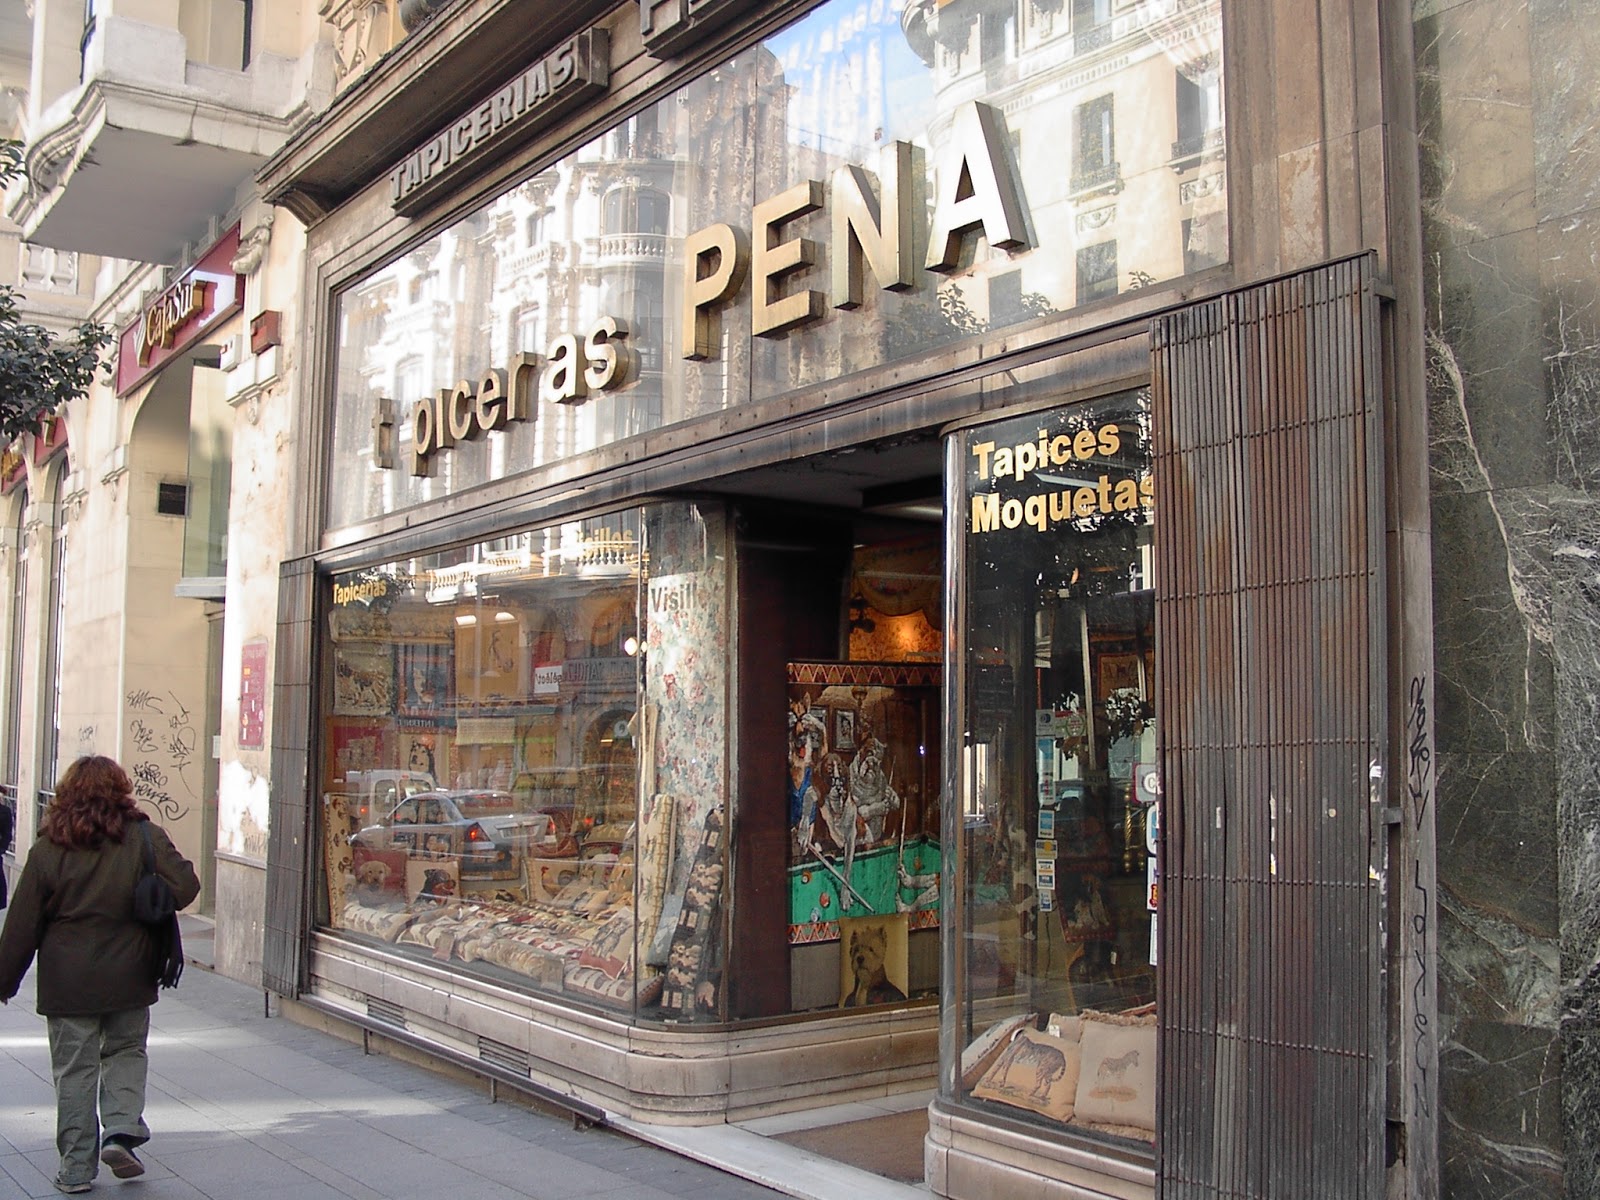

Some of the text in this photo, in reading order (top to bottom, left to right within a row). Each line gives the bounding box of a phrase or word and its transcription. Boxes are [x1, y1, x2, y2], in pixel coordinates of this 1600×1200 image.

[389, 40, 576, 202] TAPICERIAS
[147, 280, 202, 349] CajaSur
[973, 424, 1121, 482] Tapices
[972, 475, 1154, 534] Moquetas
